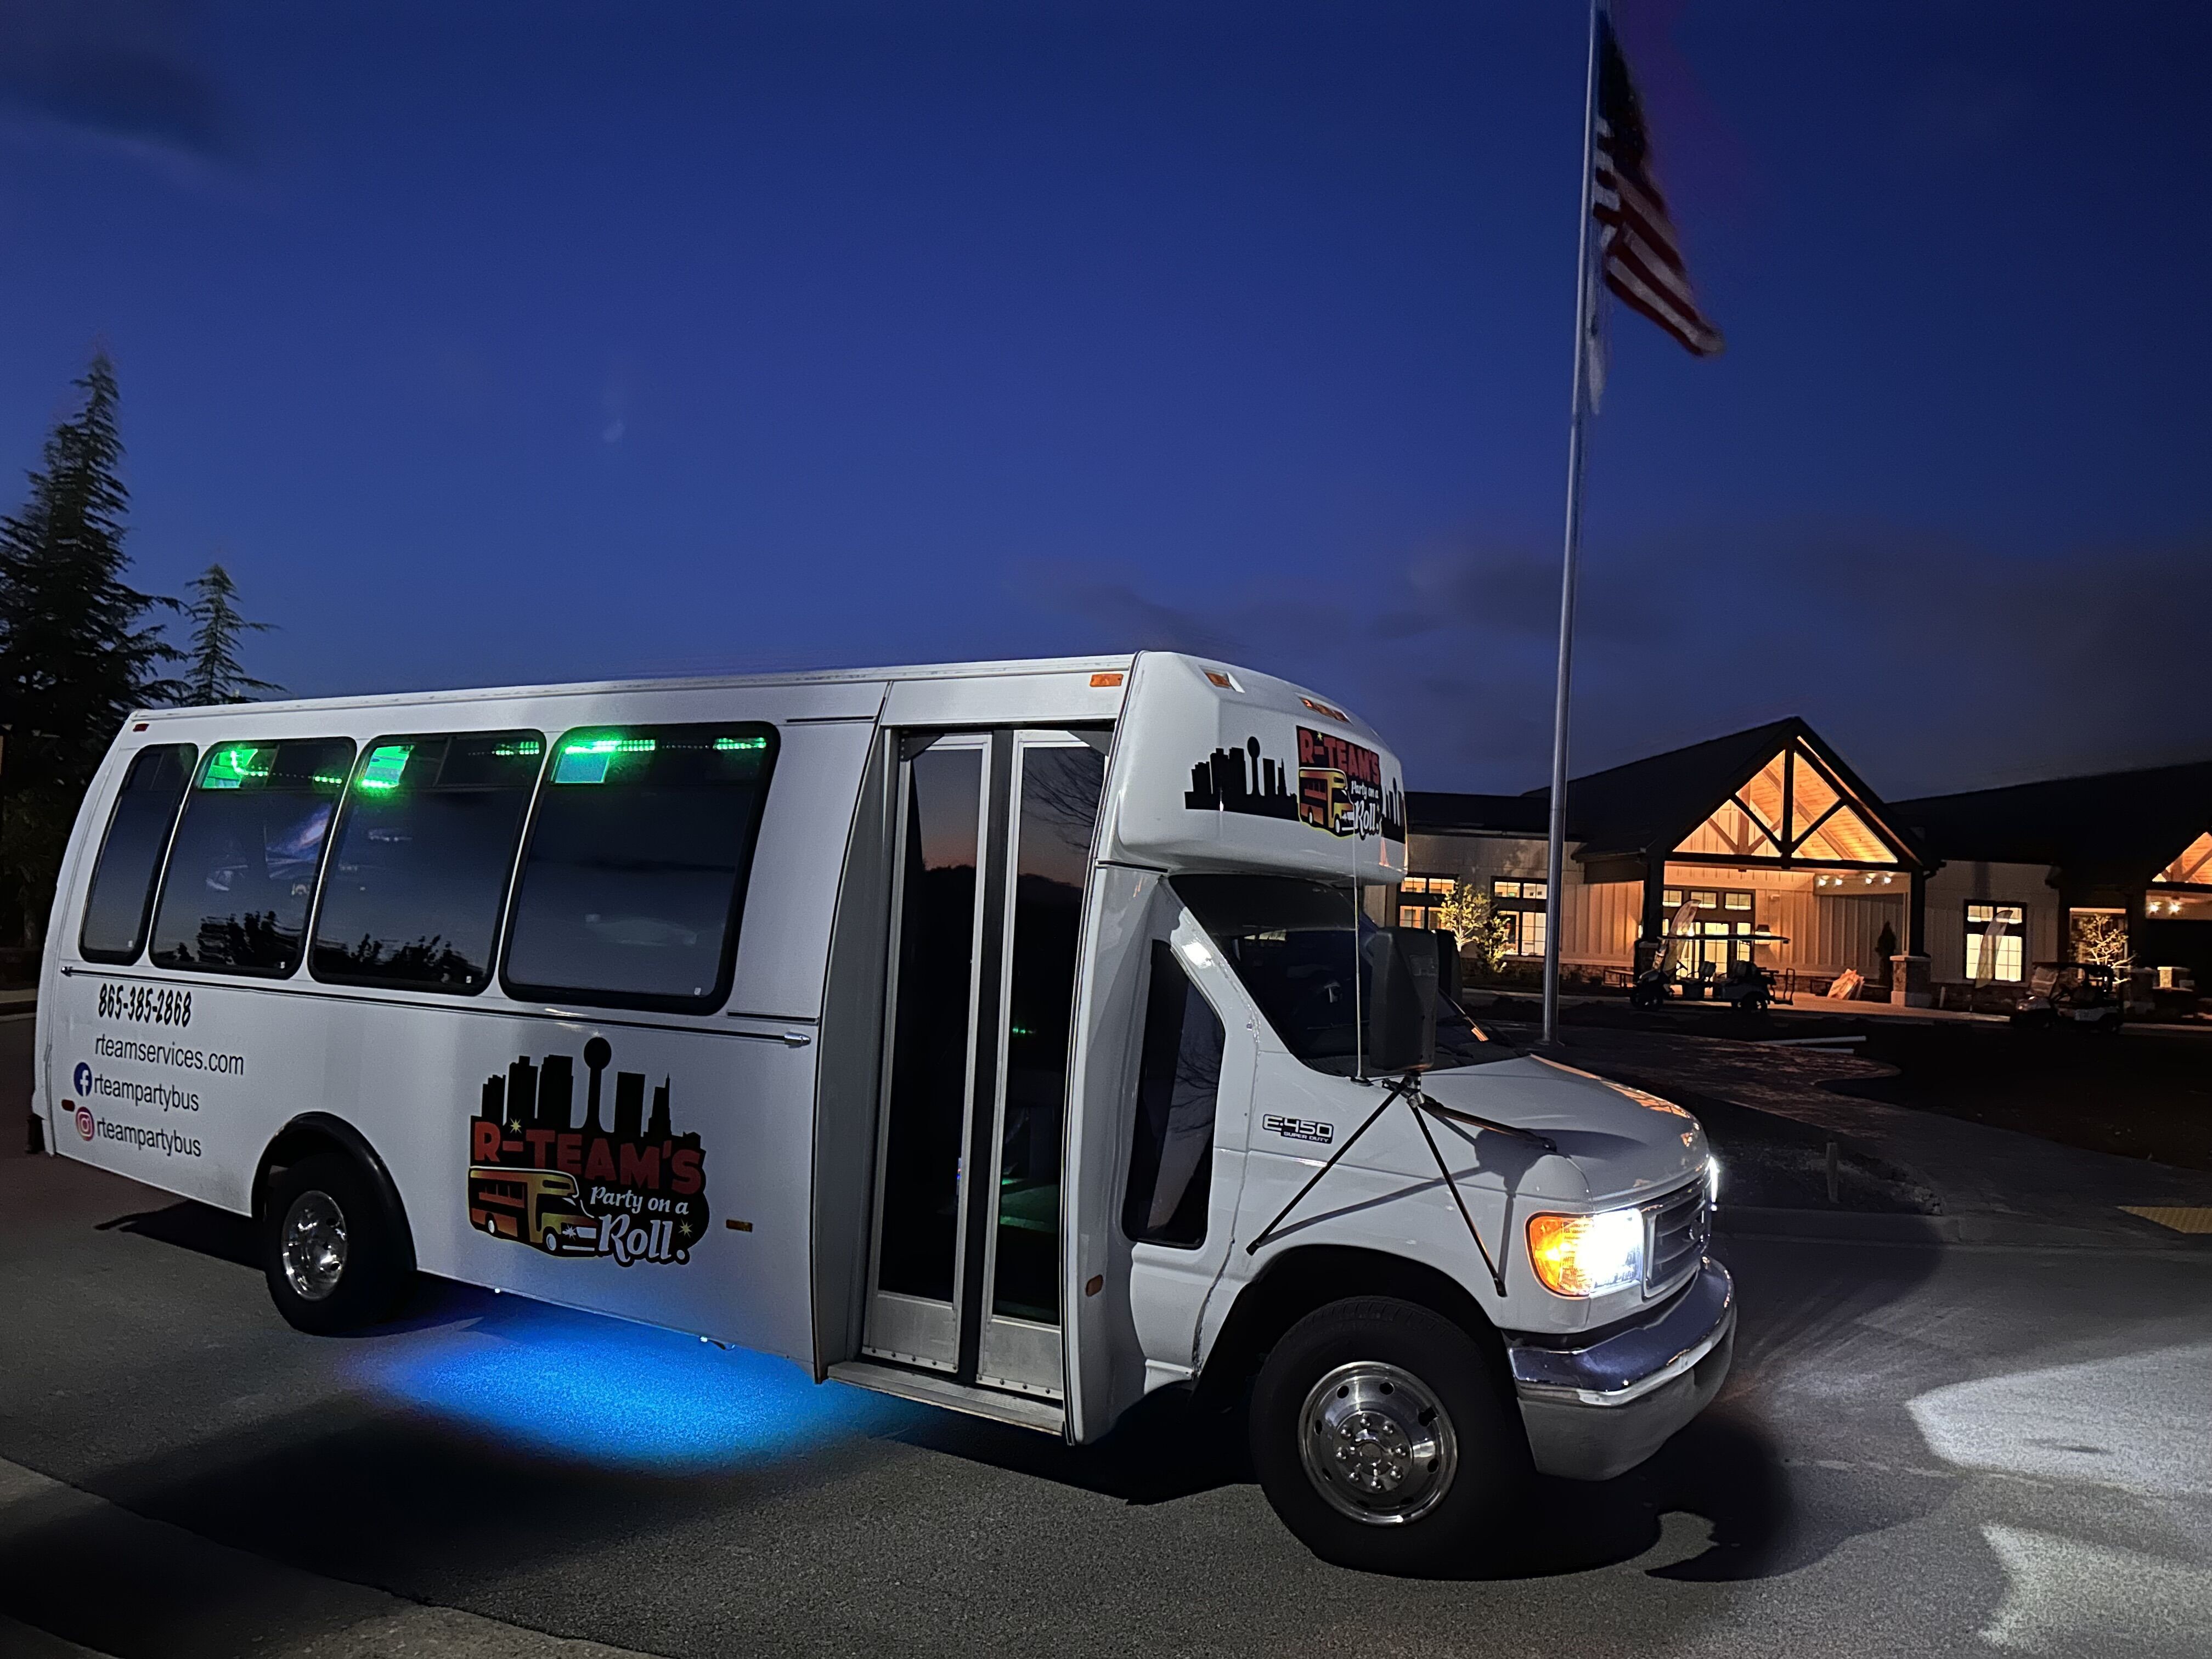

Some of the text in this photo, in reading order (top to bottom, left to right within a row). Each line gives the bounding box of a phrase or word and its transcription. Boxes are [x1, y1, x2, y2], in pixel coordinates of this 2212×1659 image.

[1299, 730, 1380, 786] R-TEAM'S
[1351, 780, 1379, 800] Party on a
[1355, 800, 1379, 836] Roll.
[98, 983, 192, 1028] 865-385-2868
[95, 1034, 244, 1075] rteamservices.com
[94, 1074, 199, 1111] rteampartybus
[97, 1118, 201, 1156] rteampartybus
[1284, 1131, 1308, 1139] SUPER
[474, 1121, 702, 1195] R-TEAM'S
[590, 1187, 689, 1215] Party on a
[599, 1214, 688, 1263] Roll.
